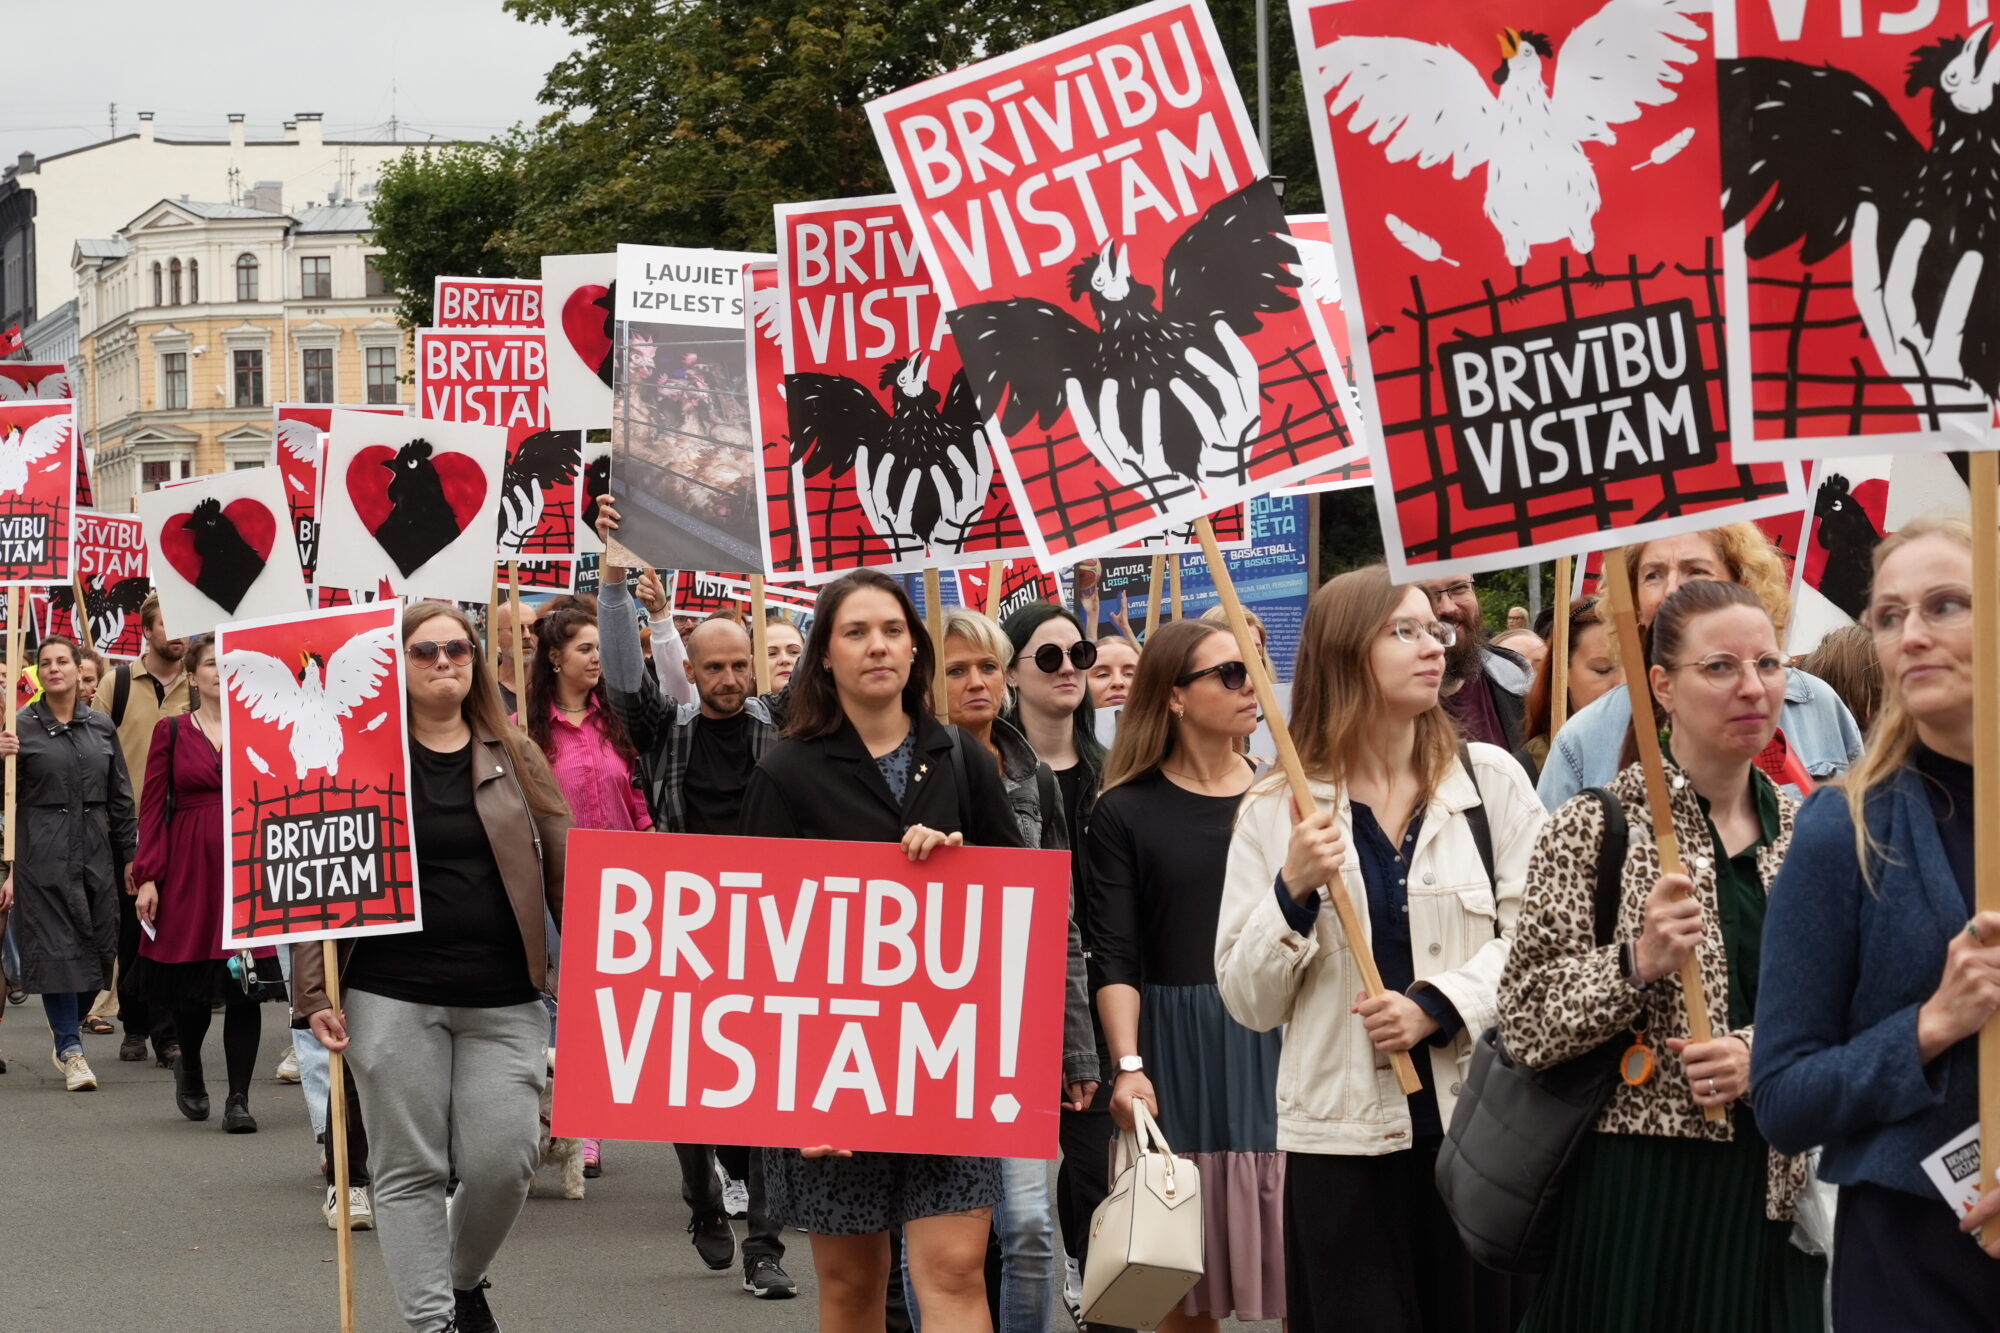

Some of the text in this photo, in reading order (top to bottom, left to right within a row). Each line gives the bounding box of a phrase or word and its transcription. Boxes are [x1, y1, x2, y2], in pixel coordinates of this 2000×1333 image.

[900, 20, 1202, 199] BRĪVĪBU
[932, 112, 1239, 291] VISTĀM
[796, 216, 921, 287] BRĪV
[646, 263, 738, 286] ĻAUJIET
[443, 287, 544, 321] BRĪVĪB
[633, 291, 743, 315] IZPLEST S
[427, 340, 545, 382] BRĪVĪB
[1452, 311, 1687, 417] BRĪVĪBU
[1463, 384, 1700, 494] VISTĀM
[1251, 496, 1294, 515] BOLA
[0, 517, 45, 538] VĪBU
[75, 517, 147, 550] RĪVĪBU
[0, 540, 44, 562] TĀM
[75, 545, 143, 577] ISTĀM
[1230, 543, 1296, 560] BASKETBALL
[1230, 554, 1299, 570] OF BASKETBALL
[1106, 564, 1144, 577] LATVIA
[1107, 577, 1129, 587] RIGA
[266, 812, 375, 860] BRĪVĪBU
[266, 853, 377, 903] VISTĀM
[596, 867, 983, 990] BRĪVĪBU
